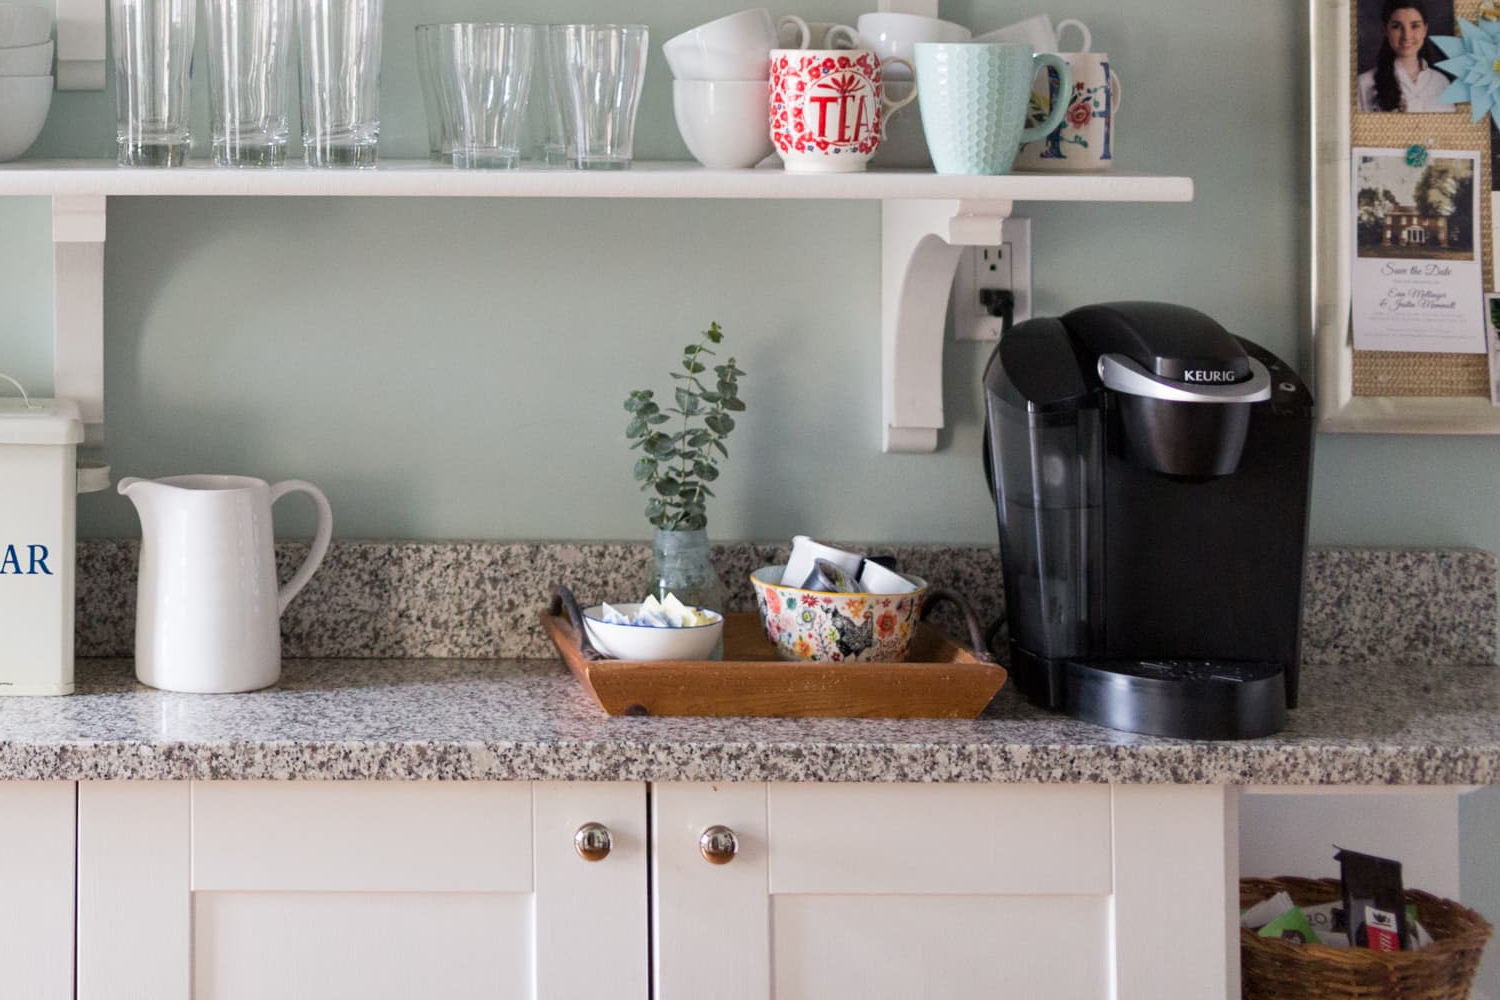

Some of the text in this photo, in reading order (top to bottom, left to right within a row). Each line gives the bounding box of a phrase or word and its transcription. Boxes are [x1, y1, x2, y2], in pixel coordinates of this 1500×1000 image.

[809, 95, 873, 143] TEA
[1410, 266, 1422, 275] the
[1425, 263, 1452, 276] Date
[1184, 369, 1235, 382] KEURIG
